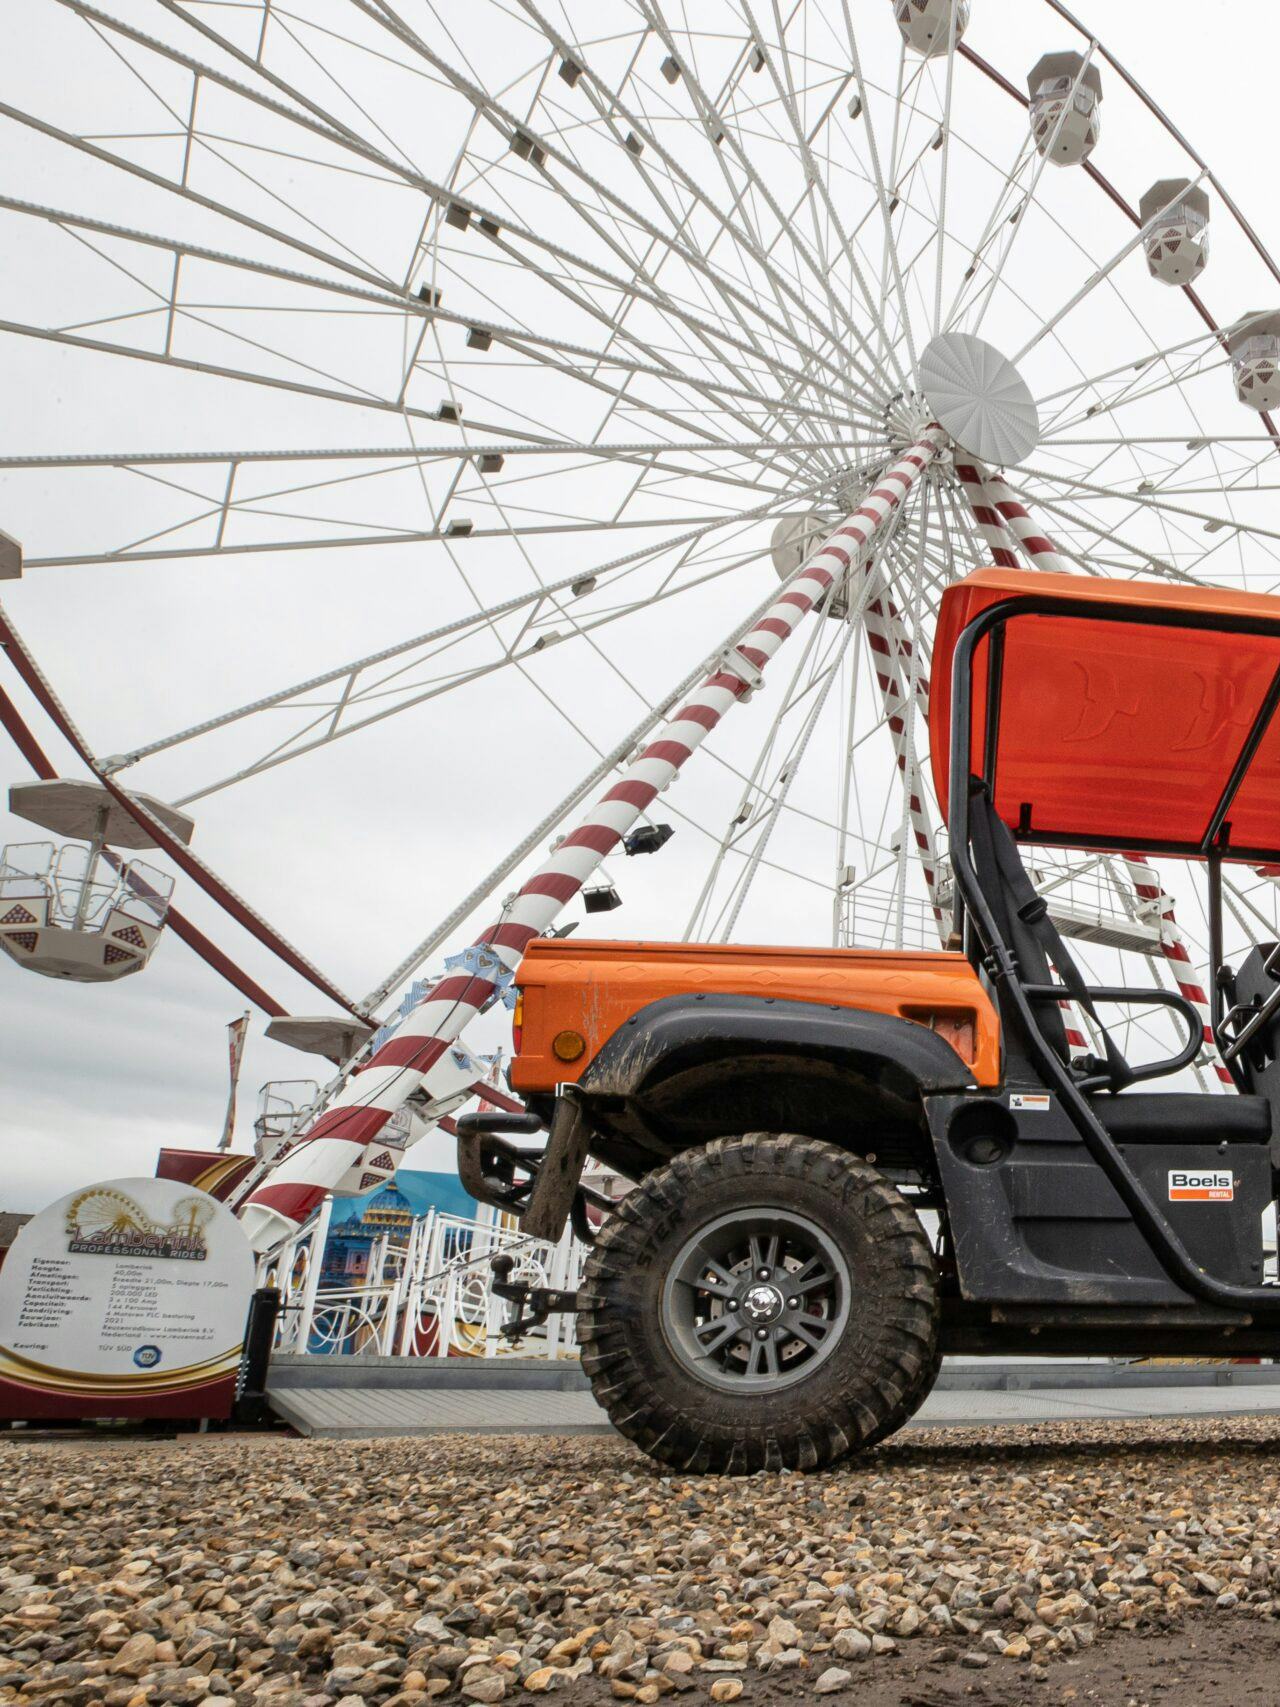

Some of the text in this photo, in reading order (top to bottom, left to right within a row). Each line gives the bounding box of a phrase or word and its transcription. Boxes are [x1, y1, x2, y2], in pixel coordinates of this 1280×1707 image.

[1172, 1174, 1230, 1187] Boels
[73, 1226, 206, 1251] Lamberink
[70, 1244, 205, 1259] PROFESSIONAL RIDES
